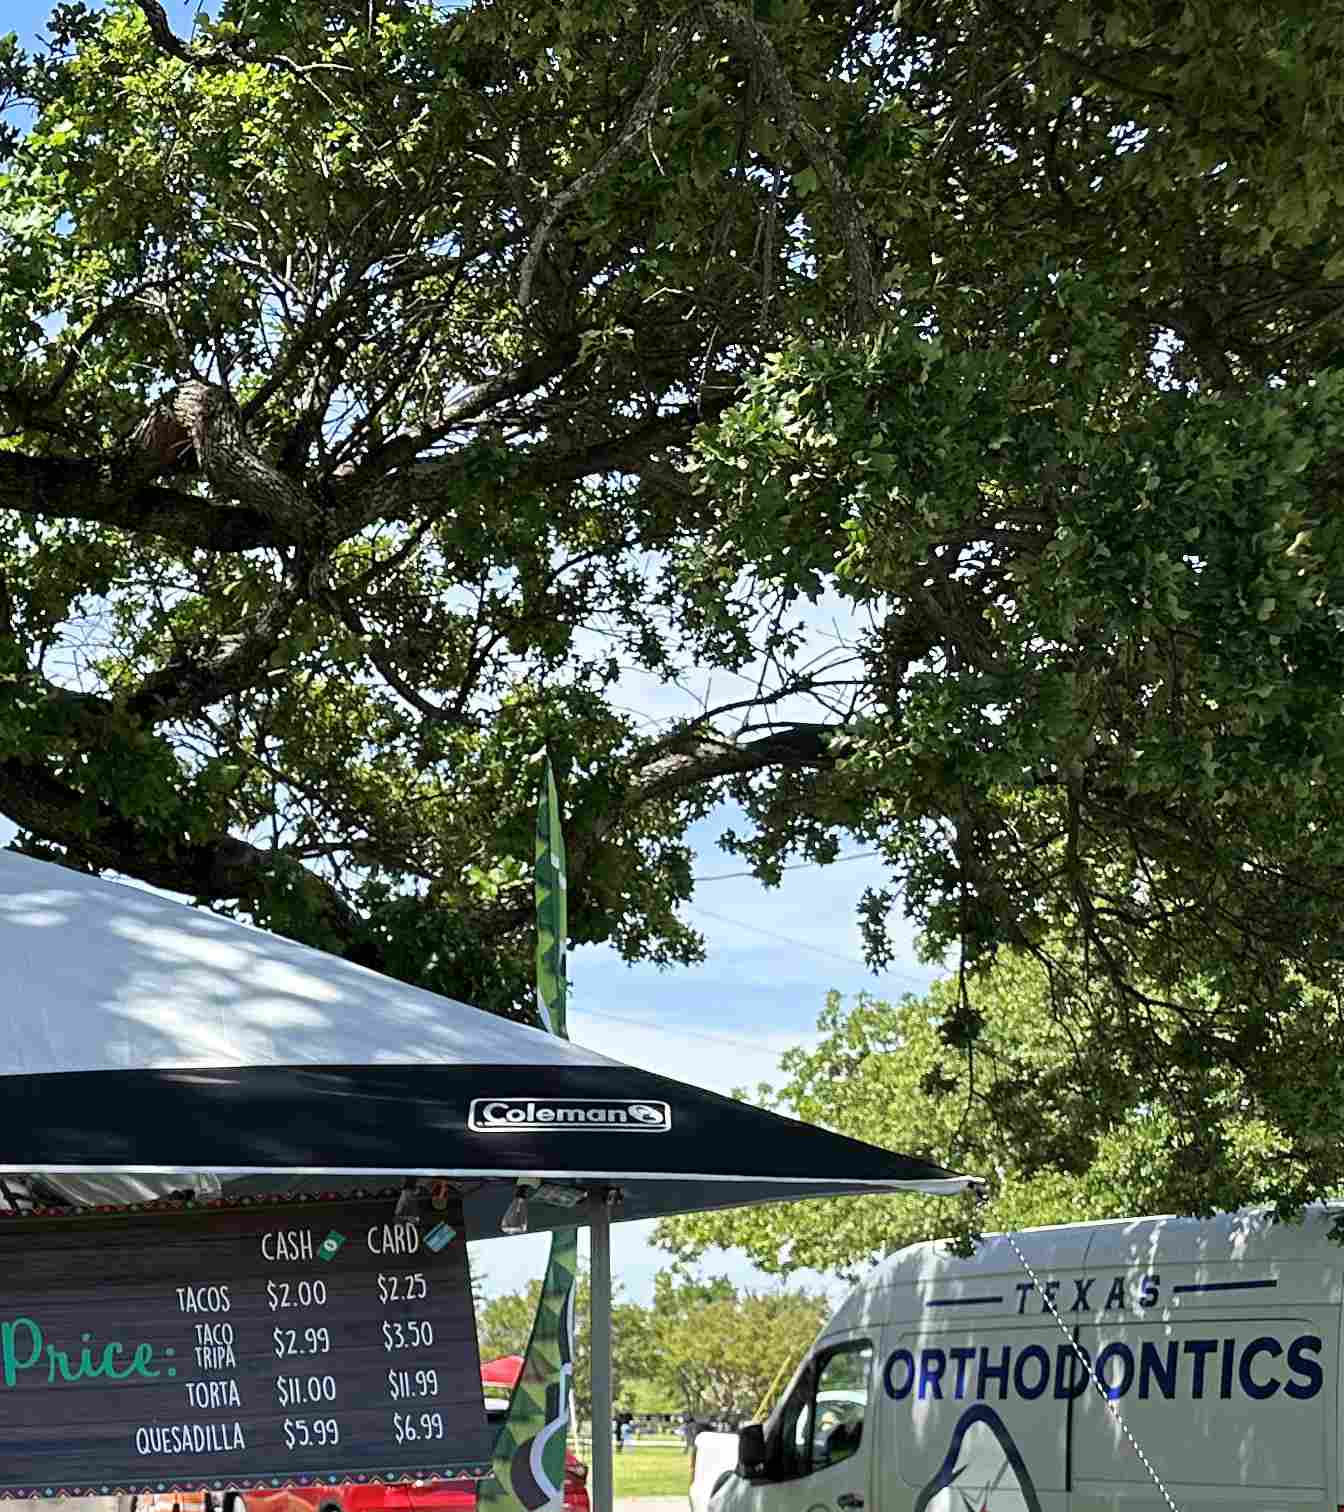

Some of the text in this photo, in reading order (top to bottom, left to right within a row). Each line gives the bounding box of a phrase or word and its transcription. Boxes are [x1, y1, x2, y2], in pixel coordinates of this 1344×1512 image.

[482, 1102, 628, 1123] Coleman
[262, 1230, 313, 1263] CASH
[367, 1223, 419, 1255] CARD
[175, 1286, 231, 1313] TACOS
[266, 1280, 327, 1312] $2.00
[377, 1273, 427, 1303] $2.25
[1015, 1274, 1161, 1315] TEXAS
[195, 1323, 234, 1346] TACO
[272, 1327, 331, 1357] $2.99
[382, 1320, 433, 1351] $3.50
[0, 1316, 177, 1387] Price:
[194, 1345, 236, 1370] TRIPA
[883, 1334, 1325, 1402] ORTHODONTICS
[185, 1381, 241, 1410] TORTA
[277, 1376, 337, 1407] $11.00
[388, 1369, 439, 1399] $11.99
[135, 1423, 245, 1457] QUESADILLA
[283, 1419, 340, 1450] $5.99
[393, 1412, 444, 1444] $6.99
